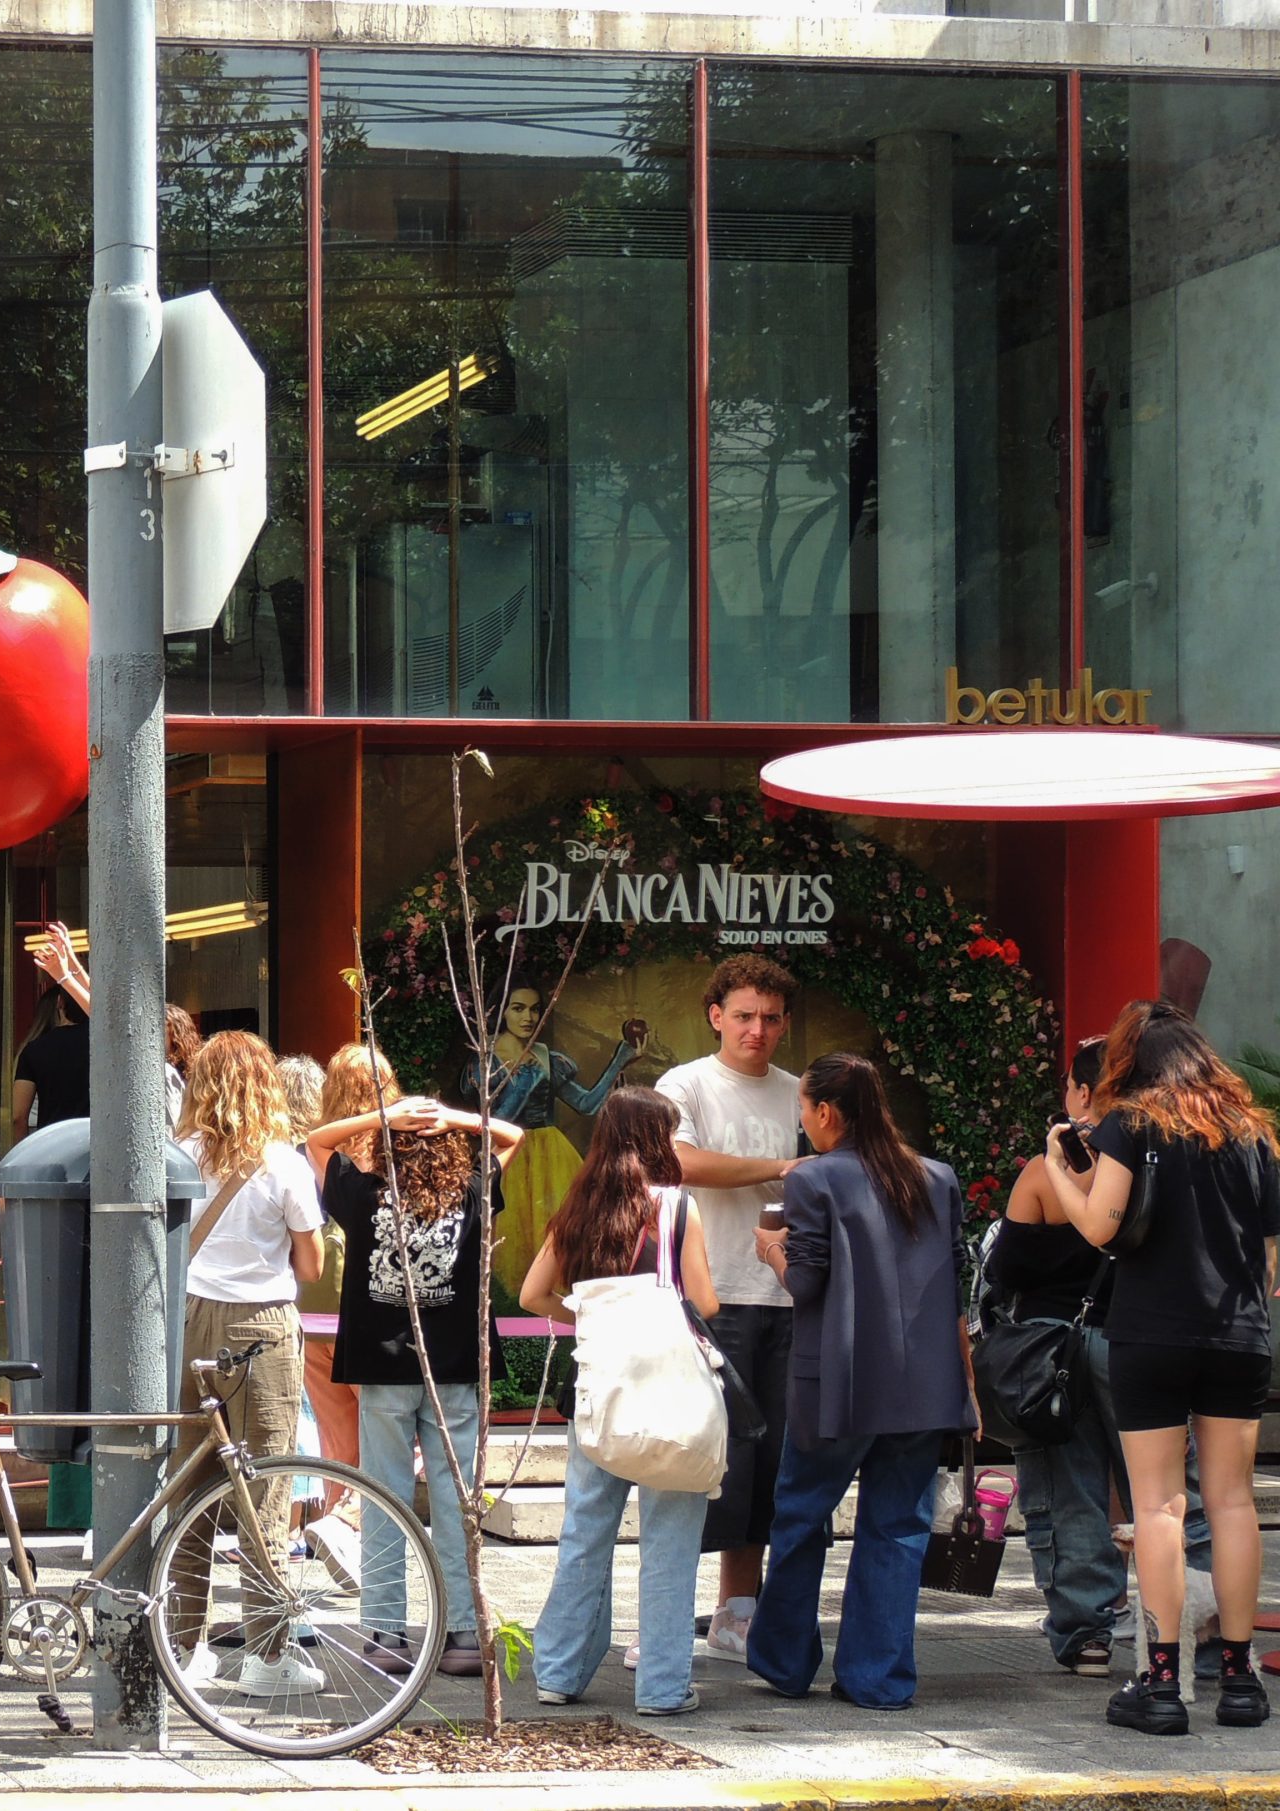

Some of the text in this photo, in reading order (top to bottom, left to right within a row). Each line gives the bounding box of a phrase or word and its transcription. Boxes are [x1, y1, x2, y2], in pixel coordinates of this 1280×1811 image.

[945, 666, 1152, 726] betular
[718, 930, 828, 945] SOLO EN CINES
[368, 1280, 456, 1299] MUSIC ESTIVAL
